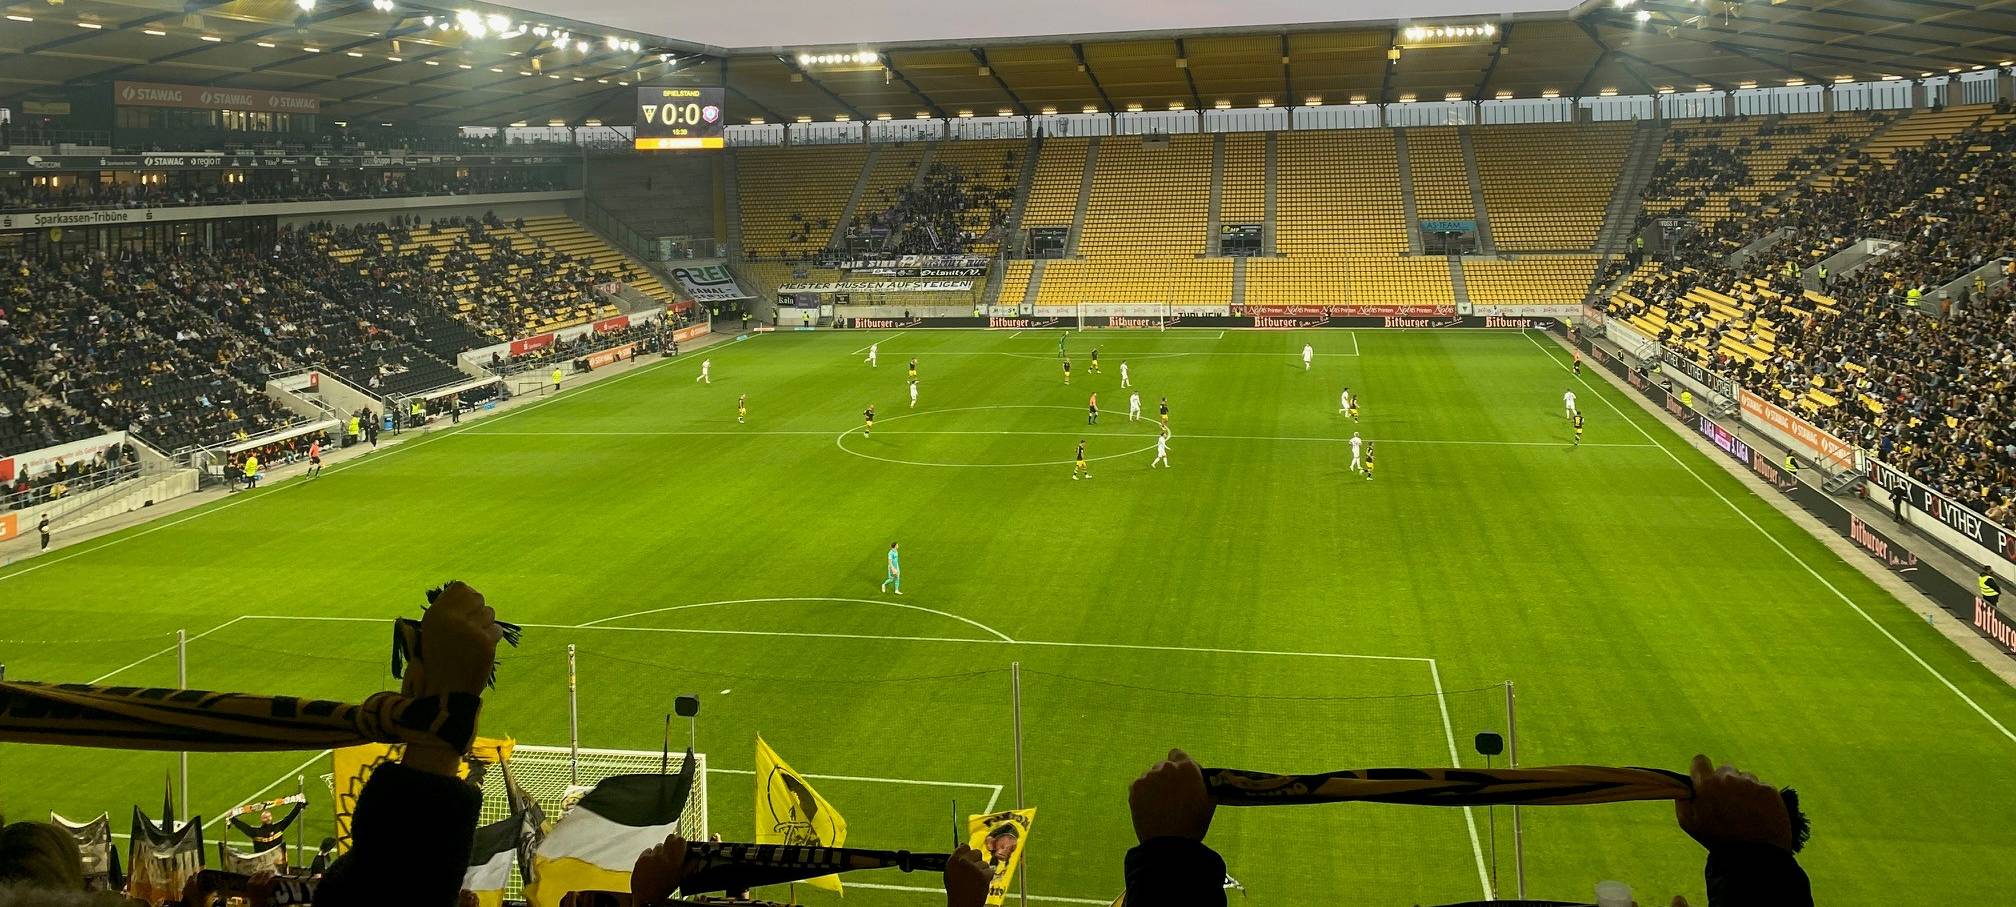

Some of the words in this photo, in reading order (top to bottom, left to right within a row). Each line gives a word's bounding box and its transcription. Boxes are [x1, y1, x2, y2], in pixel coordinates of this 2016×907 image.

[138, 88, 182, 101] STAWAG
[213, 94, 253, 106] STAWAG
[280, 97, 315, 109] STAWAG
[661, 103, 700, 125] 0:0
[154, 157, 184, 166] STAWAG
[34, 211, 128, 226] Sparkassen-Tribüne
[855, 318, 893, 328] Bitburger
[989, 317, 1029, 328] Bitburger
[1254, 316, 1297, 327] Bitburger
[1384, 316, 1429, 328] Bitburger
[1485, 316, 1531, 328] Bitburger
[1925, 491, 1983, 543] POLYTHEX
[1851, 513, 1888, 560] Bitburger
